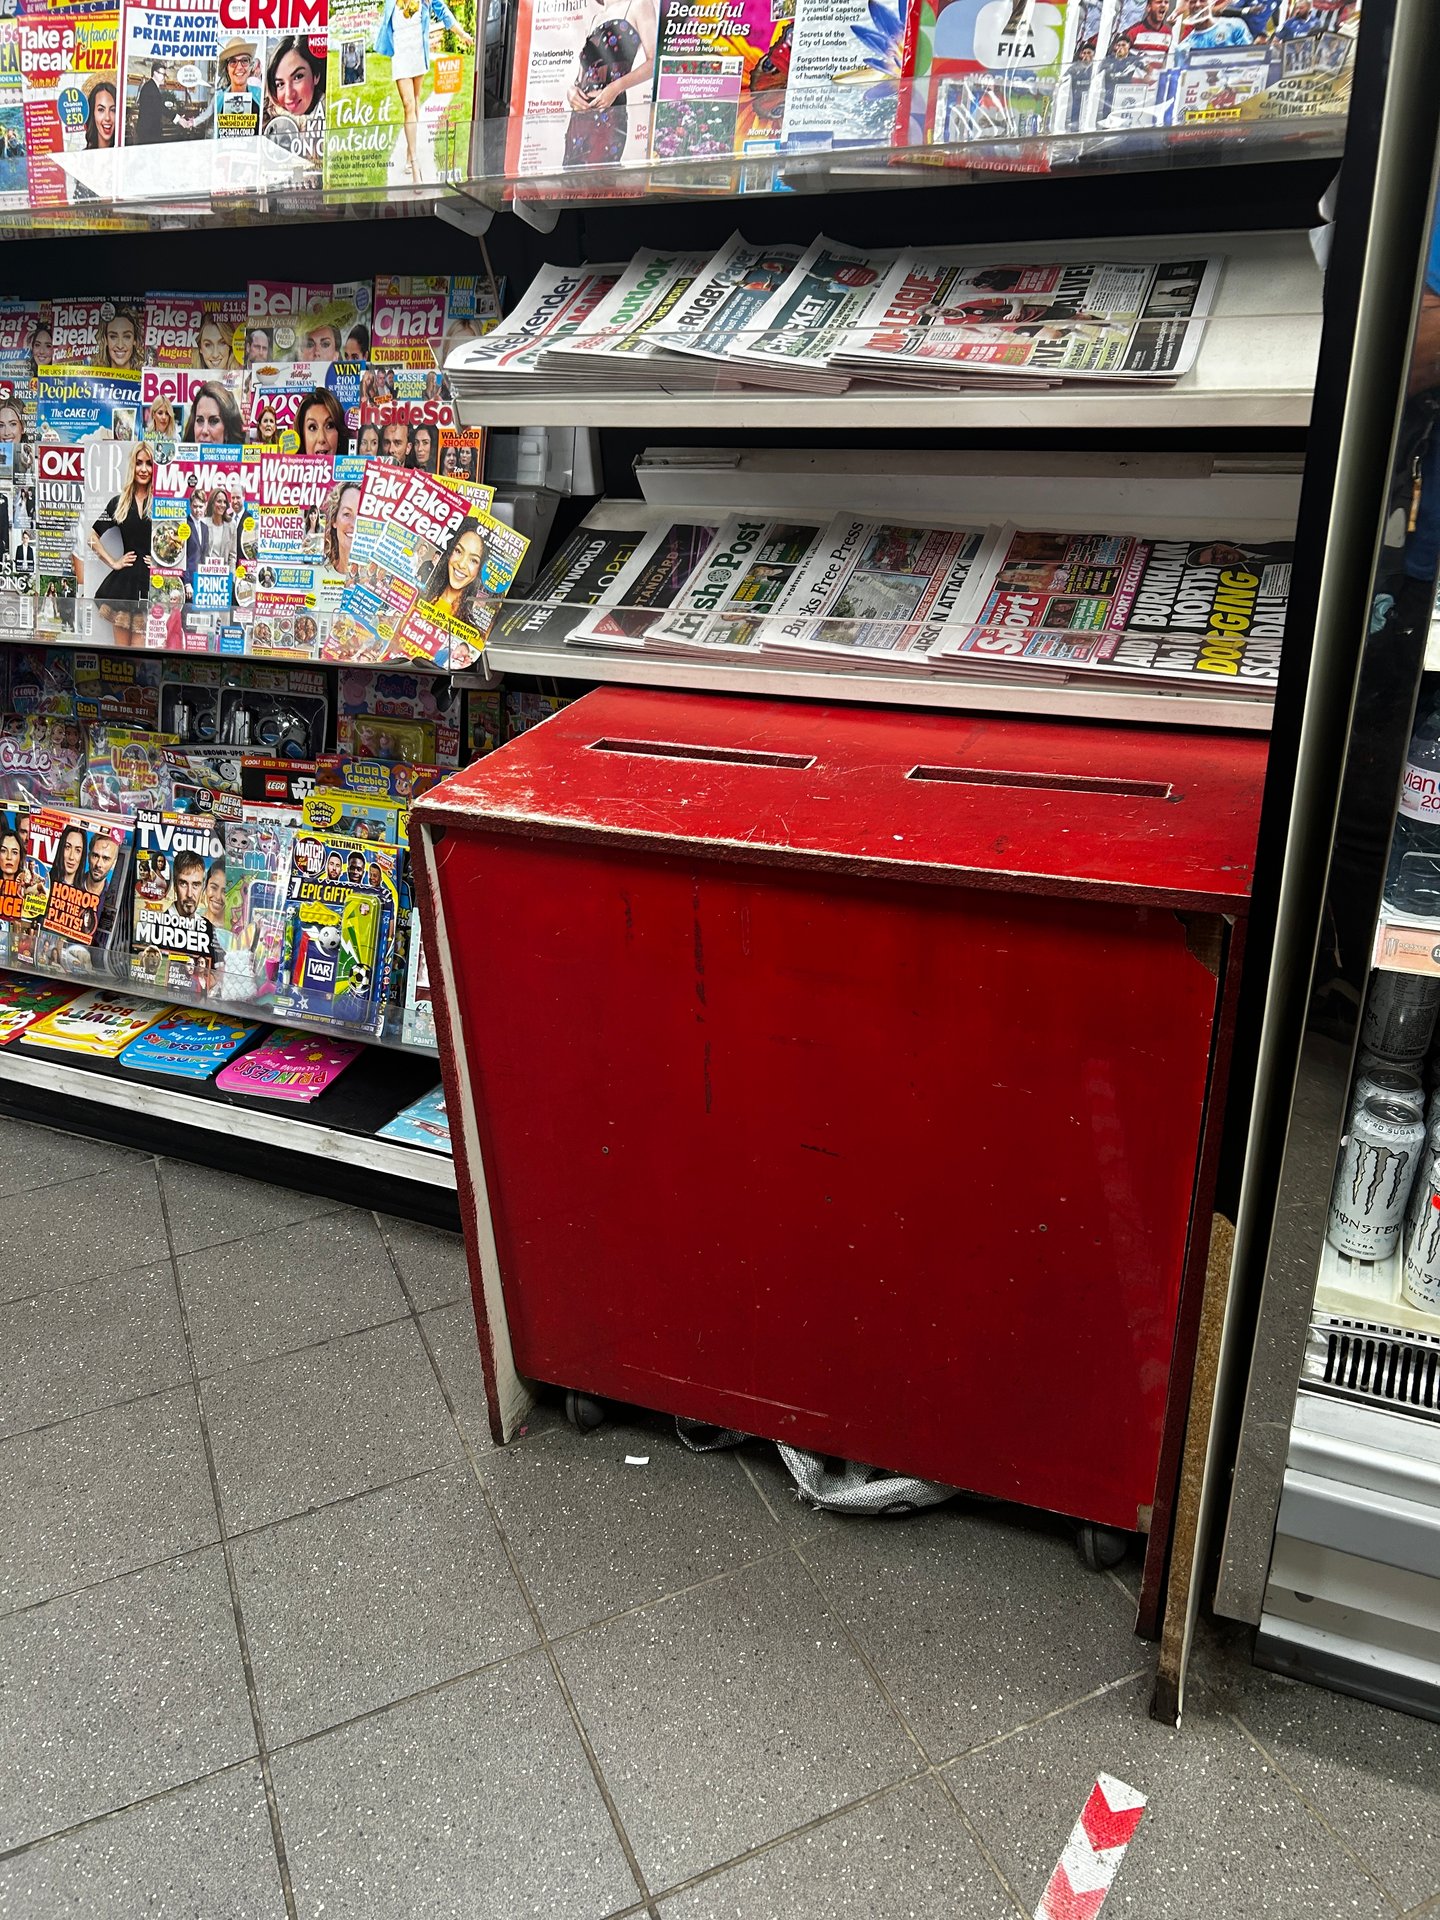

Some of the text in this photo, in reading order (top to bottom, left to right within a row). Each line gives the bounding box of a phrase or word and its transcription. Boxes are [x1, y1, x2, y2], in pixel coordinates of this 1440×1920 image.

[666, 1, 744, 20] Beautiful
[803, 6, 834, 15] Pyramid's
[145, 13, 171, 27] YET
[19, 25, 74, 49] Take a
[133, 26, 180, 42] PRIME
[665, 20, 750, 38] butterflies
[678, 37, 700, 45] spotting
[21, 50, 73, 71] Break
[797, 56, 830, 65] Forgotten
[804, 73, 833, 81] humanity
[66, 90, 79, 102] 10
[329, 96, 392, 126] Take it
[66, 114, 84, 125] £50
[328, 126, 393, 154] outside!
[361, 154, 382, 162] garden
[454, 277, 474, 288] WIN
[248, 284, 331, 316] Bella
[666, 278, 691, 307] WORLD
[204, 302, 221, 312] WIN
[677, 278, 729, 326] RUGBY
[53, 306, 88, 325] Take
[90, 308, 100, 325] a
[145, 305, 201, 328] Take a
[213, 313, 229, 322] THIS
[374, 304, 442, 337] Chat
[464, 275, 582, 364] Weekender
[53, 327, 99, 345] Break
[145, 326, 199, 348] Break
[382, 336, 408, 346] August
[159, 347, 192, 359] August
[375, 350, 422, 361] STABBED ON
[334, 364, 360, 375] WIN!
[40, 382, 91, 403] People's
[394, 382, 426, 390] POISONS
[14, 391, 32, 399] PRIZE
[51, 409, 86, 418] The CAKE
[42, 451, 84, 477] OK!
[262, 459, 332, 483] Woman's
[155, 464, 193, 497] My
[425, 477, 447, 495] favourite
[39, 483, 84, 502] HOLLY
[263, 482, 327, 508] Weekly
[467, 487, 490, 500] WEEK
[156, 507, 187, 517] DINNERS
[405, 477, 464, 531] Take a
[261, 516, 303, 529] LONGER
[393, 500, 454, 550] Break
[260, 530, 303, 539] HEALTHIER
[478, 514, 526, 551] WIN WEEK
[260, 539, 301, 551] & happier
[477, 525, 522, 560] OF TREATS!
[709, 522, 766, 571] Post
[812, 521, 864, 597] Free Press
[198, 577, 229, 592] PRINCE
[521, 540, 607, 632] THE WORLD
[940, 561, 971, 608] ATTACK
[1112, 546, 1149, 627] SPORT EXCLUSIVE
[1130, 542, 1191, 627] BURNHAM
[195, 593, 229, 608] GEORGE
[257, 593, 303, 603] Recipes from
[1169, 567, 1222, 628] NORTH
[409, 612, 433, 634] Fake
[977, 594, 1040, 655] Sport
[1196, 570, 1259, 676] DOGGING
[402, 624, 433, 651] had a
[1240, 596, 1290, 678] SCANDAL!
[77, 660, 97, 669] GIFTS!
[101, 658, 135, 675] Bob
[289, 669, 325, 686] WILD
[289, 682, 325, 697] WHEELS
[77, 702, 98, 713] Bob
[101, 703, 118, 712] MEGA
[135, 707, 149, 716] SET!
[439, 740, 456, 748] PLAY
[0, 738, 51, 771] Cute
[163, 751, 176, 762] 13
[203, 749, 245, 757] GROWN-UPS!
[266, 781, 286, 791] LEGO
[348, 772, 388, 787] CBeebies
[201, 791, 209, 799] 13
[221, 795, 241, 806] MEGA
[138, 810, 160, 823] Total
[214, 804, 231, 815] RACE
[31, 823, 53, 835] What's
[258, 818, 281, 826] STAR
[30, 835, 59, 864] TV
[296, 842, 324, 857] MATCH
[331, 839, 364, 851] ULTIMATE
[307, 857, 324, 872] DAY
[53, 883, 100, 911] HORROR
[140, 887, 163, 895] RAPTURE
[301, 884, 322, 900] EPIC
[27, 895, 47, 907] Benidorm
[50, 898, 79, 915] FOR THE
[30, 906, 45, 914] Murder
[49, 909, 83, 931] PLATTS!
[139, 911, 207, 932] BENIDORM IS
[136, 922, 210, 953] MURDER
[311, 962, 333, 977] VAR
[168, 979, 193, 987] REVENGE!
[57, 1007, 148, 1029] ACTIVITY
[143, 1033, 236, 1051] DINOSAURS
[233, 1060, 329, 1085] PRINCESS
[1387, 1126, 1415, 1136] SUGAR
[1345, 1238, 1374, 1250] ULTRA
